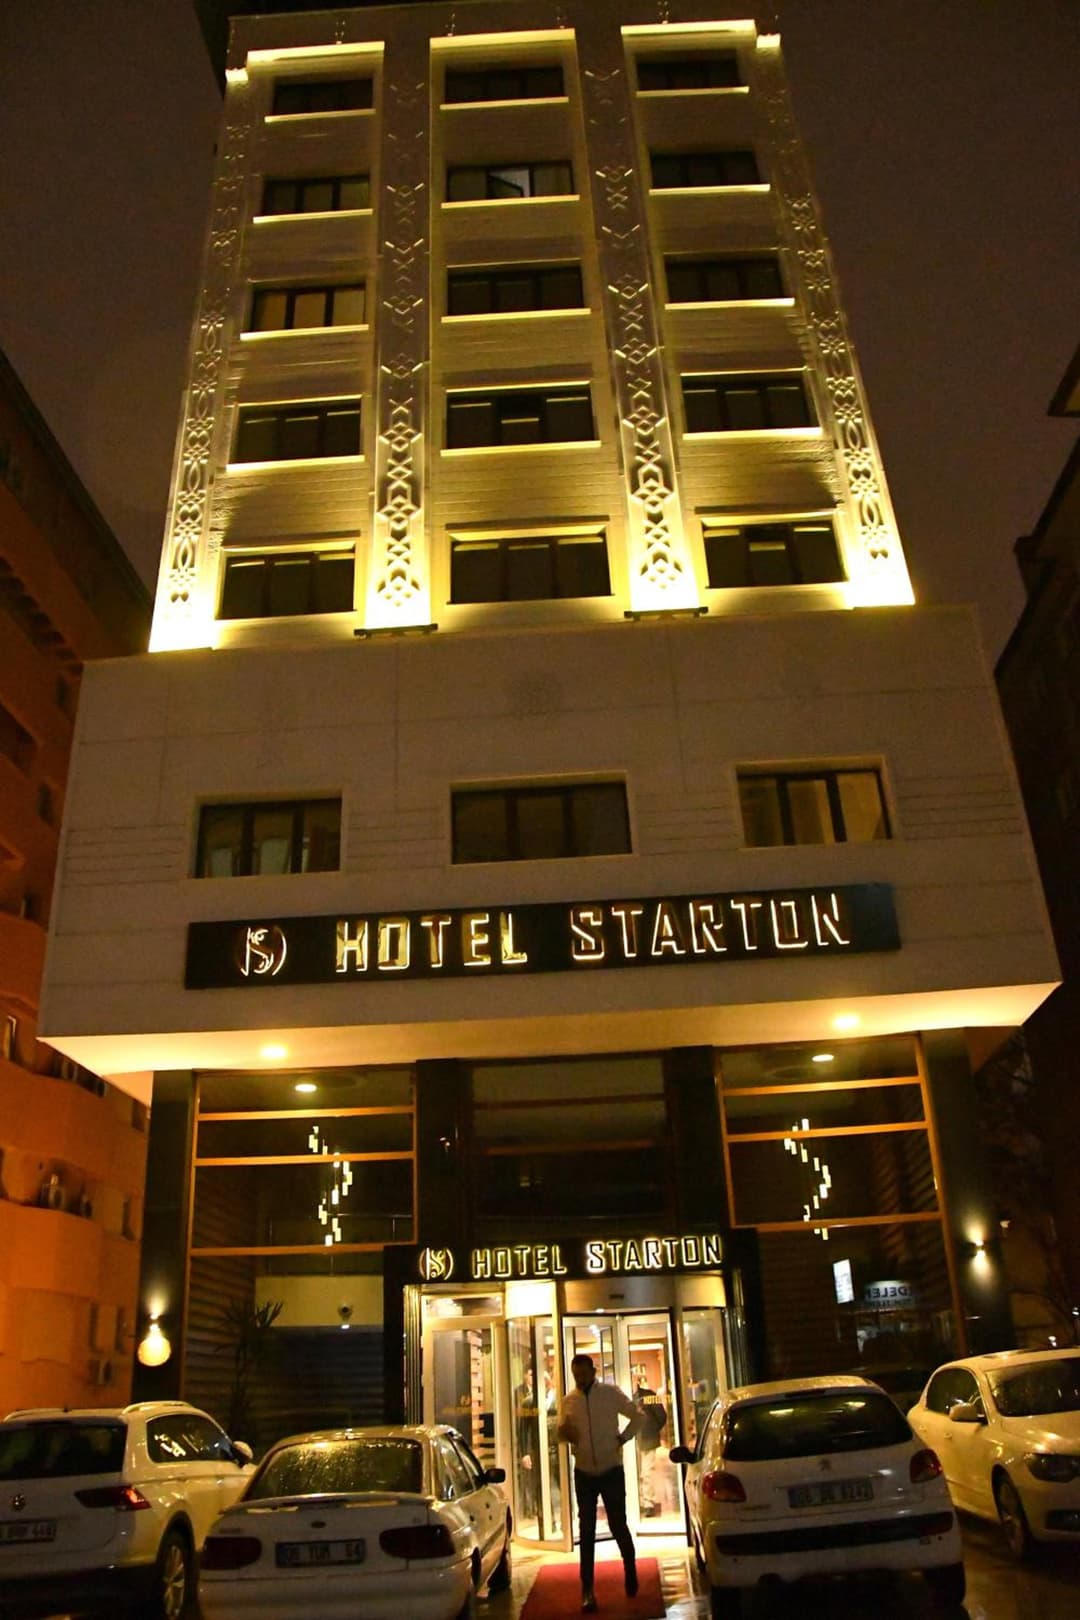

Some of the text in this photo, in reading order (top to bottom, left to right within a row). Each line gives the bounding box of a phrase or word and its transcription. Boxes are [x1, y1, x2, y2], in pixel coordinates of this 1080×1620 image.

[335, 912, 528, 973] HOTEL
[570, 893, 850, 960] STARTON
[472, 1245, 568, 1279] HOTEL
[587, 1234, 722, 1274] STARTON
